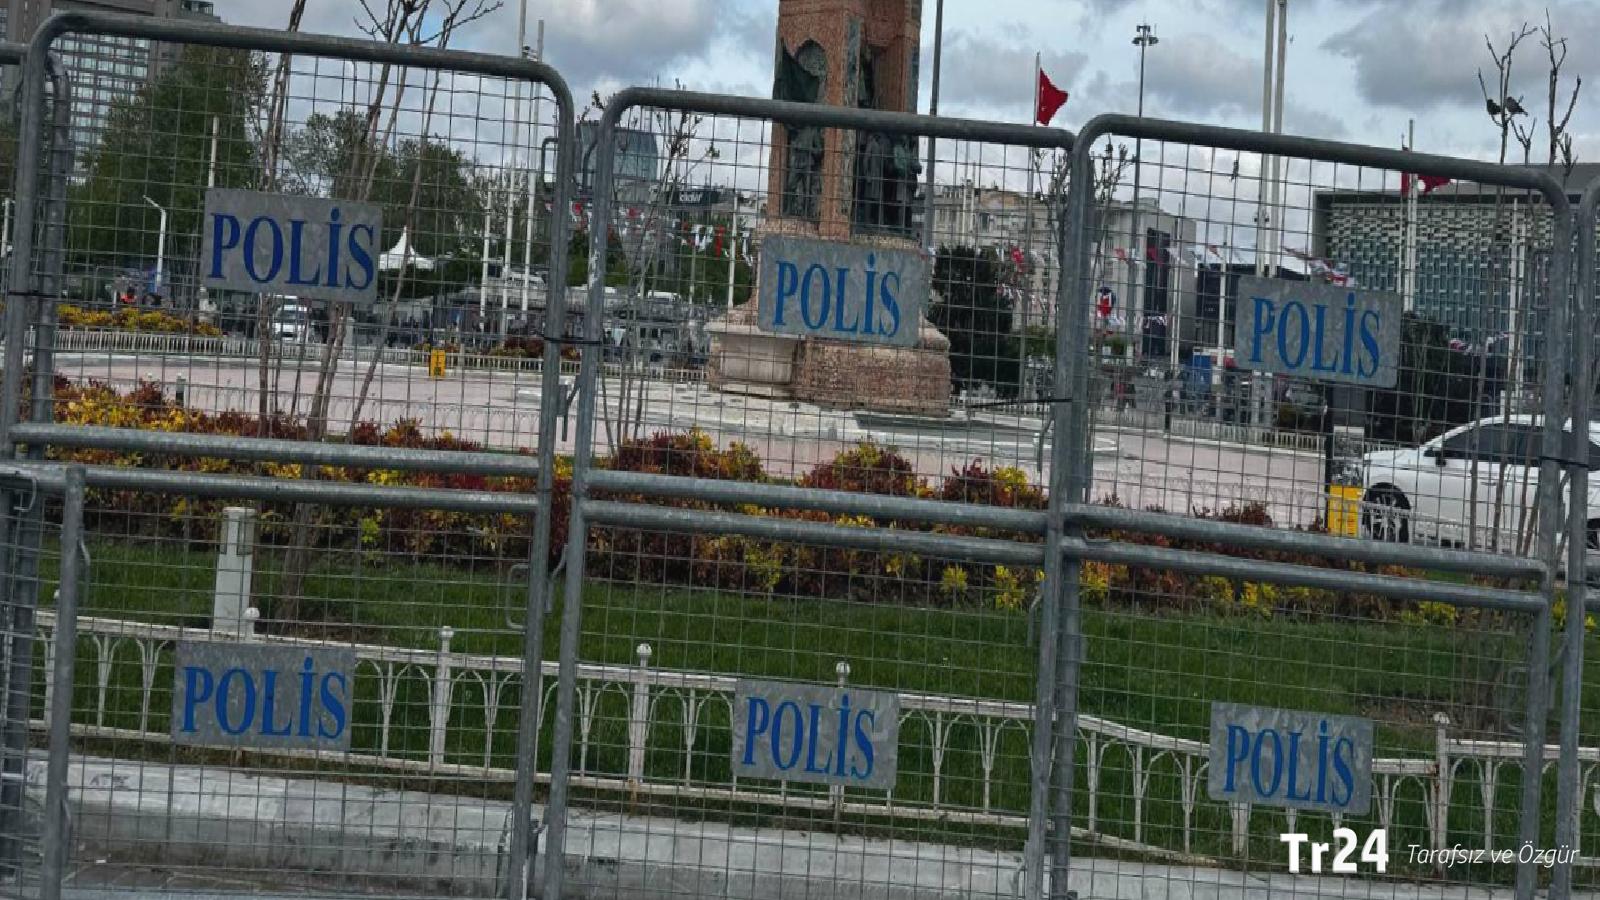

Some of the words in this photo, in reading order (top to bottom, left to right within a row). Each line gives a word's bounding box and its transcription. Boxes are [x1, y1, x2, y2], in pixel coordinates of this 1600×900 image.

[207, 206, 375, 290] POLİS
[772, 253, 900, 338] POLİS
[1249, 293, 1380, 378] POLİS
[181, 656, 347, 738] POLİS
[742, 694, 875, 780] POLİS
[1224, 719, 1354, 806] POLİS
